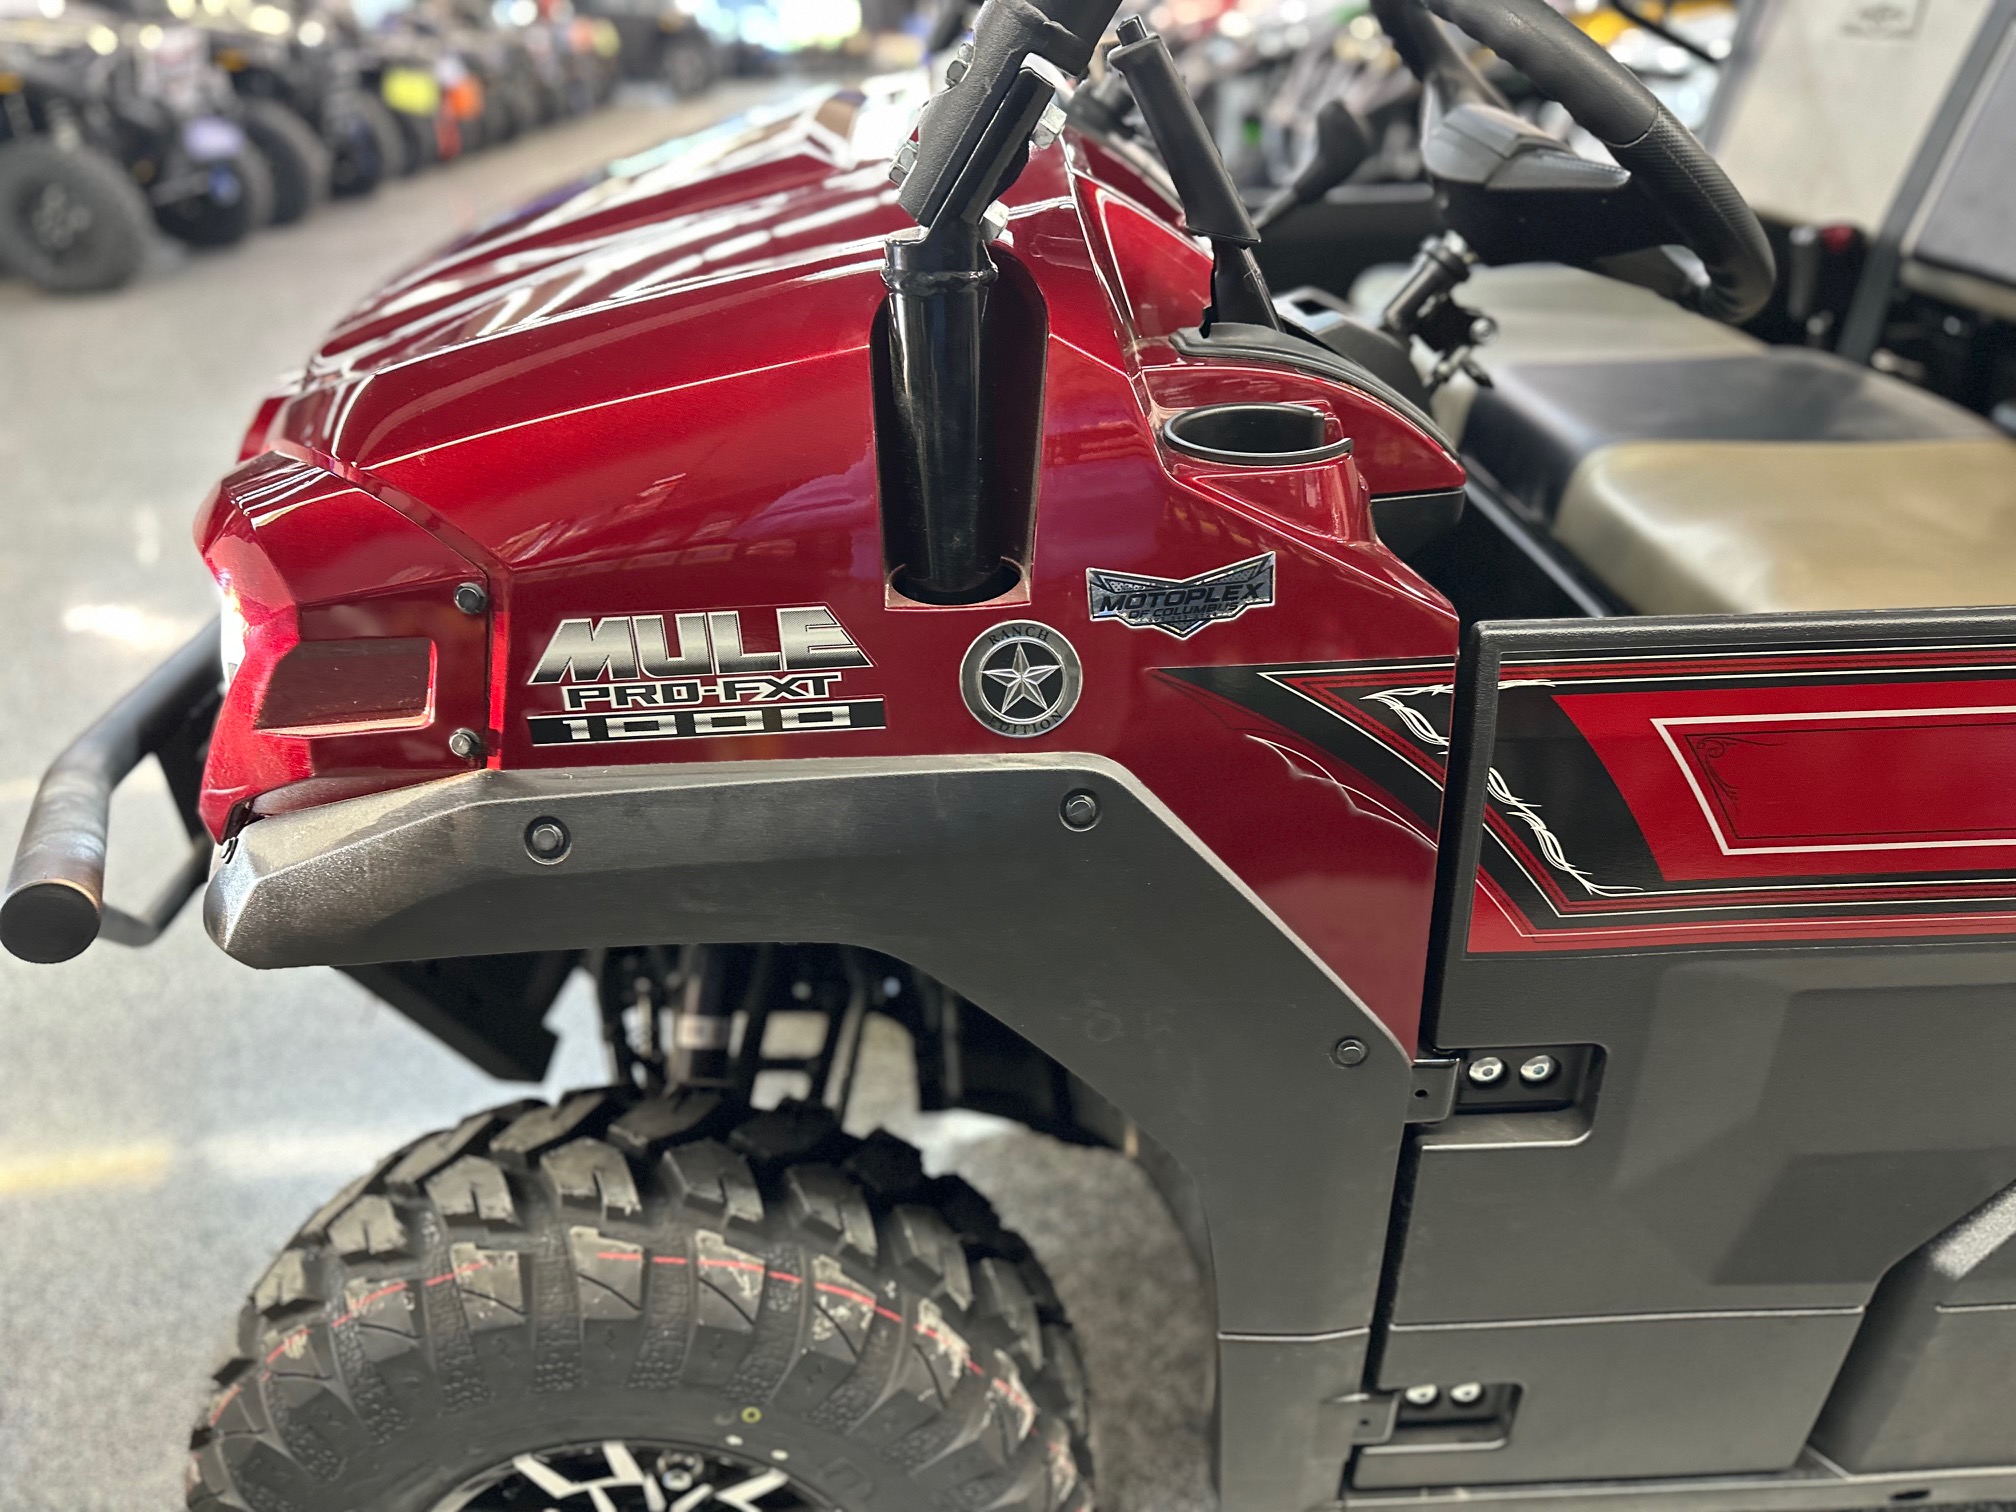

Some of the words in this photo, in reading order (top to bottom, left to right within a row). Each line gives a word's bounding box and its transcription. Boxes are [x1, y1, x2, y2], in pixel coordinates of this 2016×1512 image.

[1099, 582, 1266, 612] MOTOPLEX
[1128, 609, 1151, 620] OF
[1152, 601, 1239, 617] COLUMBUS
[526, 605, 875, 686] MULE
[988, 626, 1050, 645] RANCH
[561, 672, 842, 712] PRO-FXT
[562, 706, 852, 741] 1000
[990, 710, 1063, 734] EDITION
